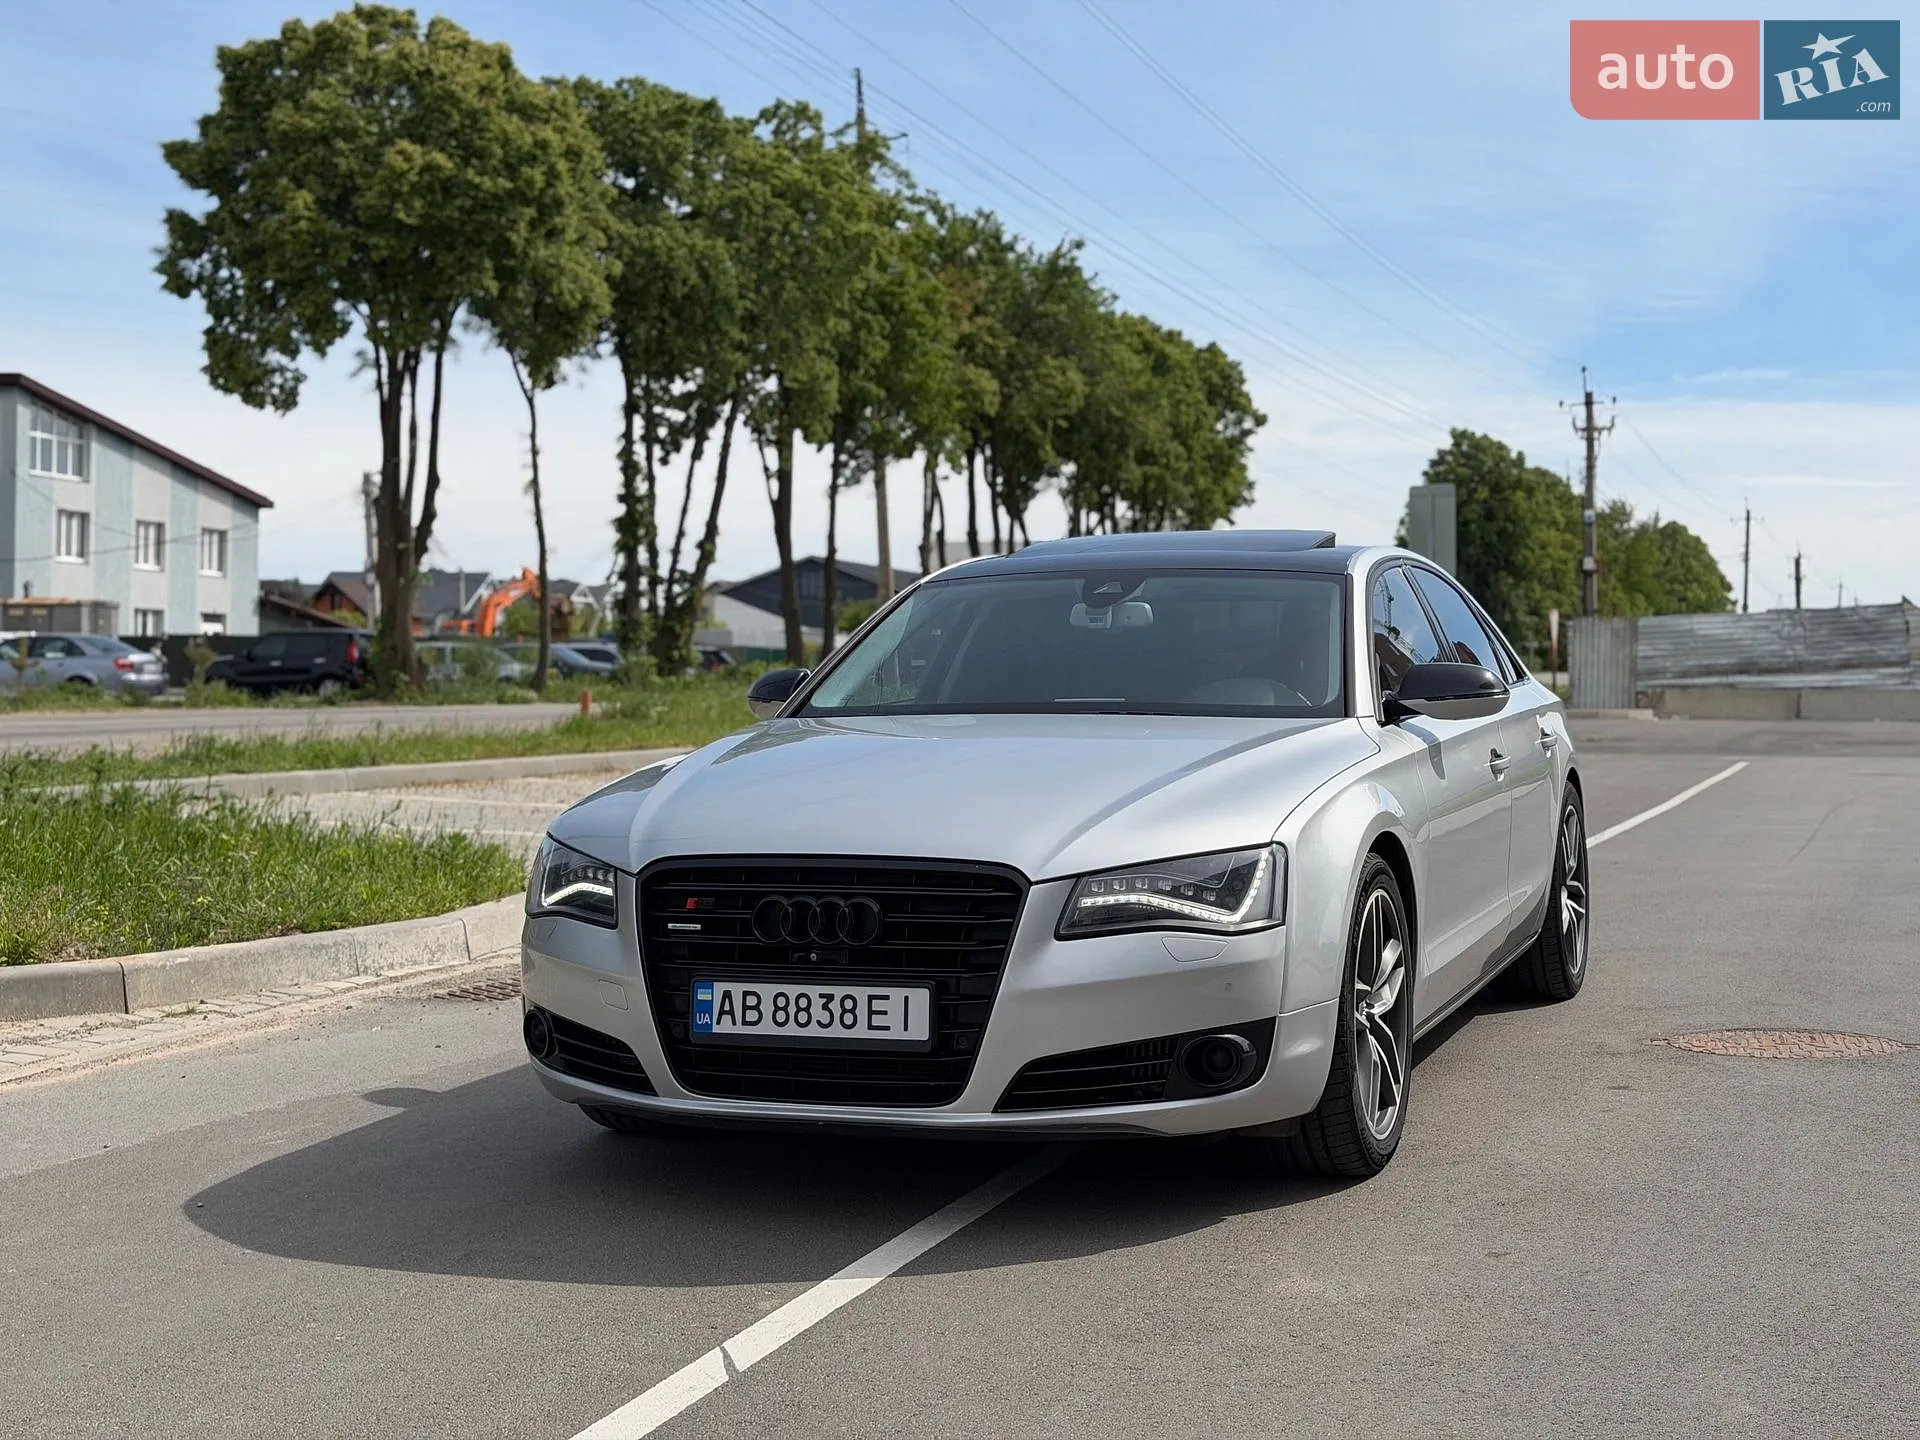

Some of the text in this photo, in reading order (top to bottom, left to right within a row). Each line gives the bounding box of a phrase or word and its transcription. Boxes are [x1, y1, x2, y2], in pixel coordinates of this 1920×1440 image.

[696, 1012, 711, 1025] UA
[715, 989, 909, 1032] AB 8838 EI
